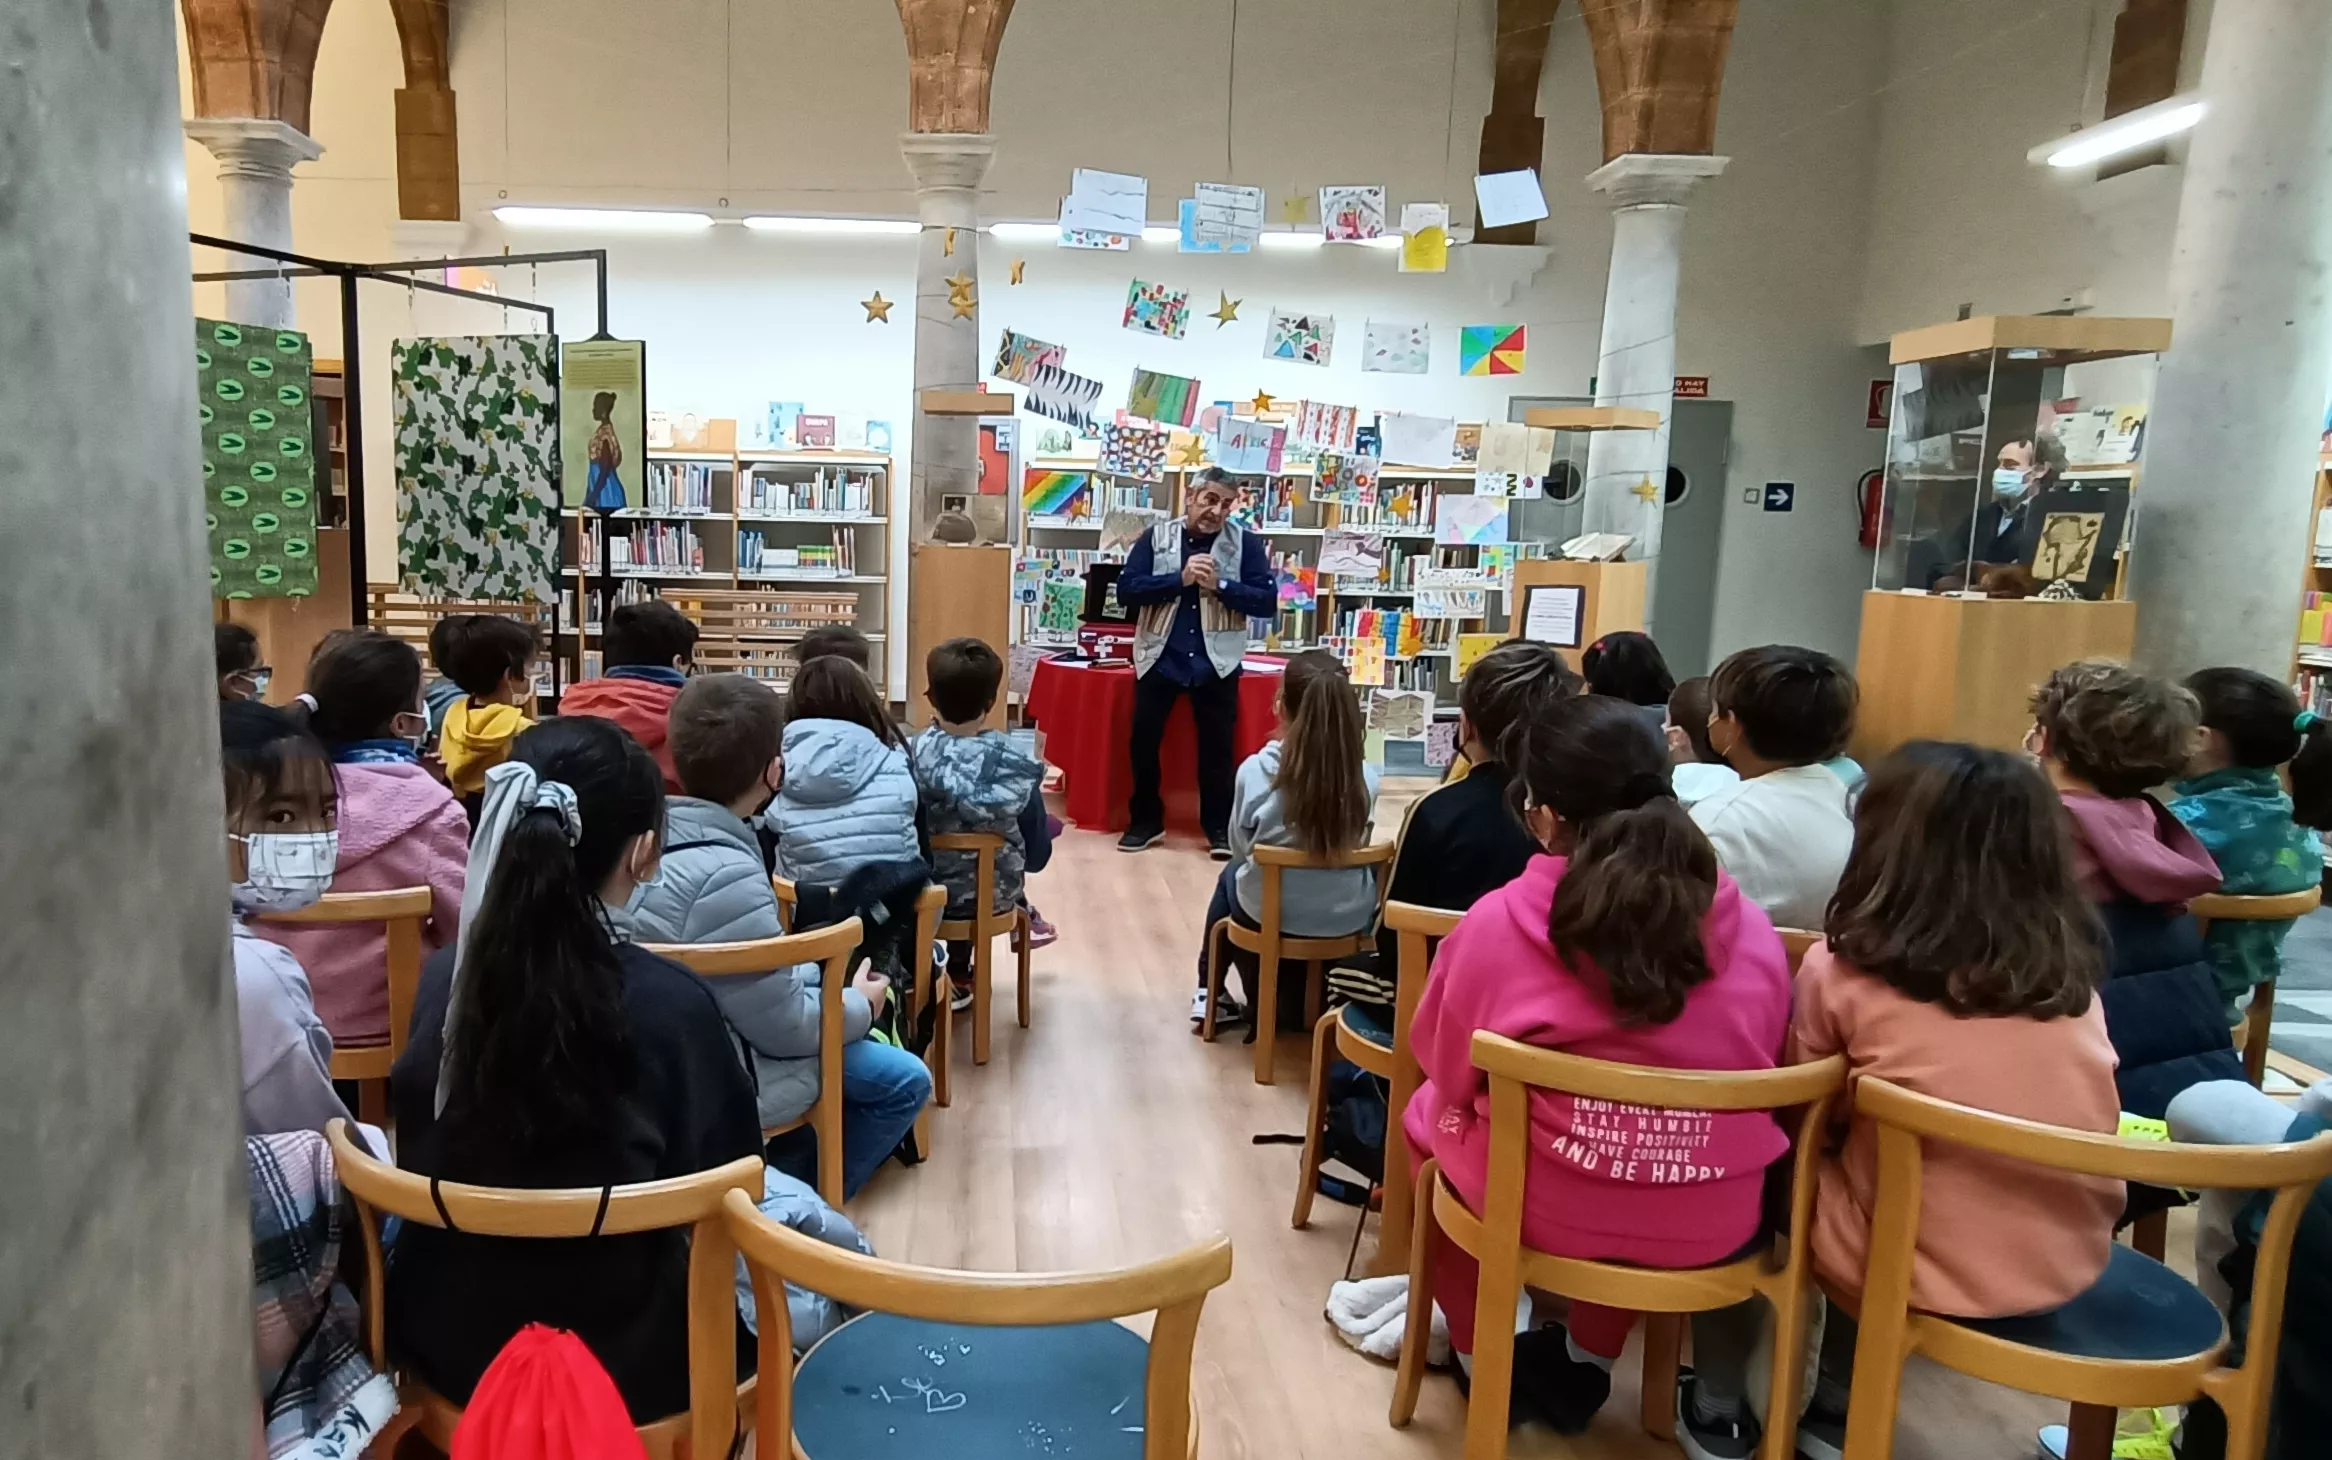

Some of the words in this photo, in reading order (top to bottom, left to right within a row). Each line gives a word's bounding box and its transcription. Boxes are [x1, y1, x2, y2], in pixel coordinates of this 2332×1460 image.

[1674, 387, 1705, 395] ALIDA
[1573, 1097, 1613, 1113] ENJOY
[1573, 1111, 1620, 1128] STAY
[1638, 1117, 1713, 1133] HUMBLE
[1571, 1123, 1629, 1145] INSPIRE
[1636, 1132, 1710, 1148] POSITIVITY
[1551, 1135, 1599, 1170] AND
[1610, 1159, 1639, 1182] BE
[1652, 1162, 1726, 1183] HAPPY
[1631, 1147, 1691, 1163] COURAGE
